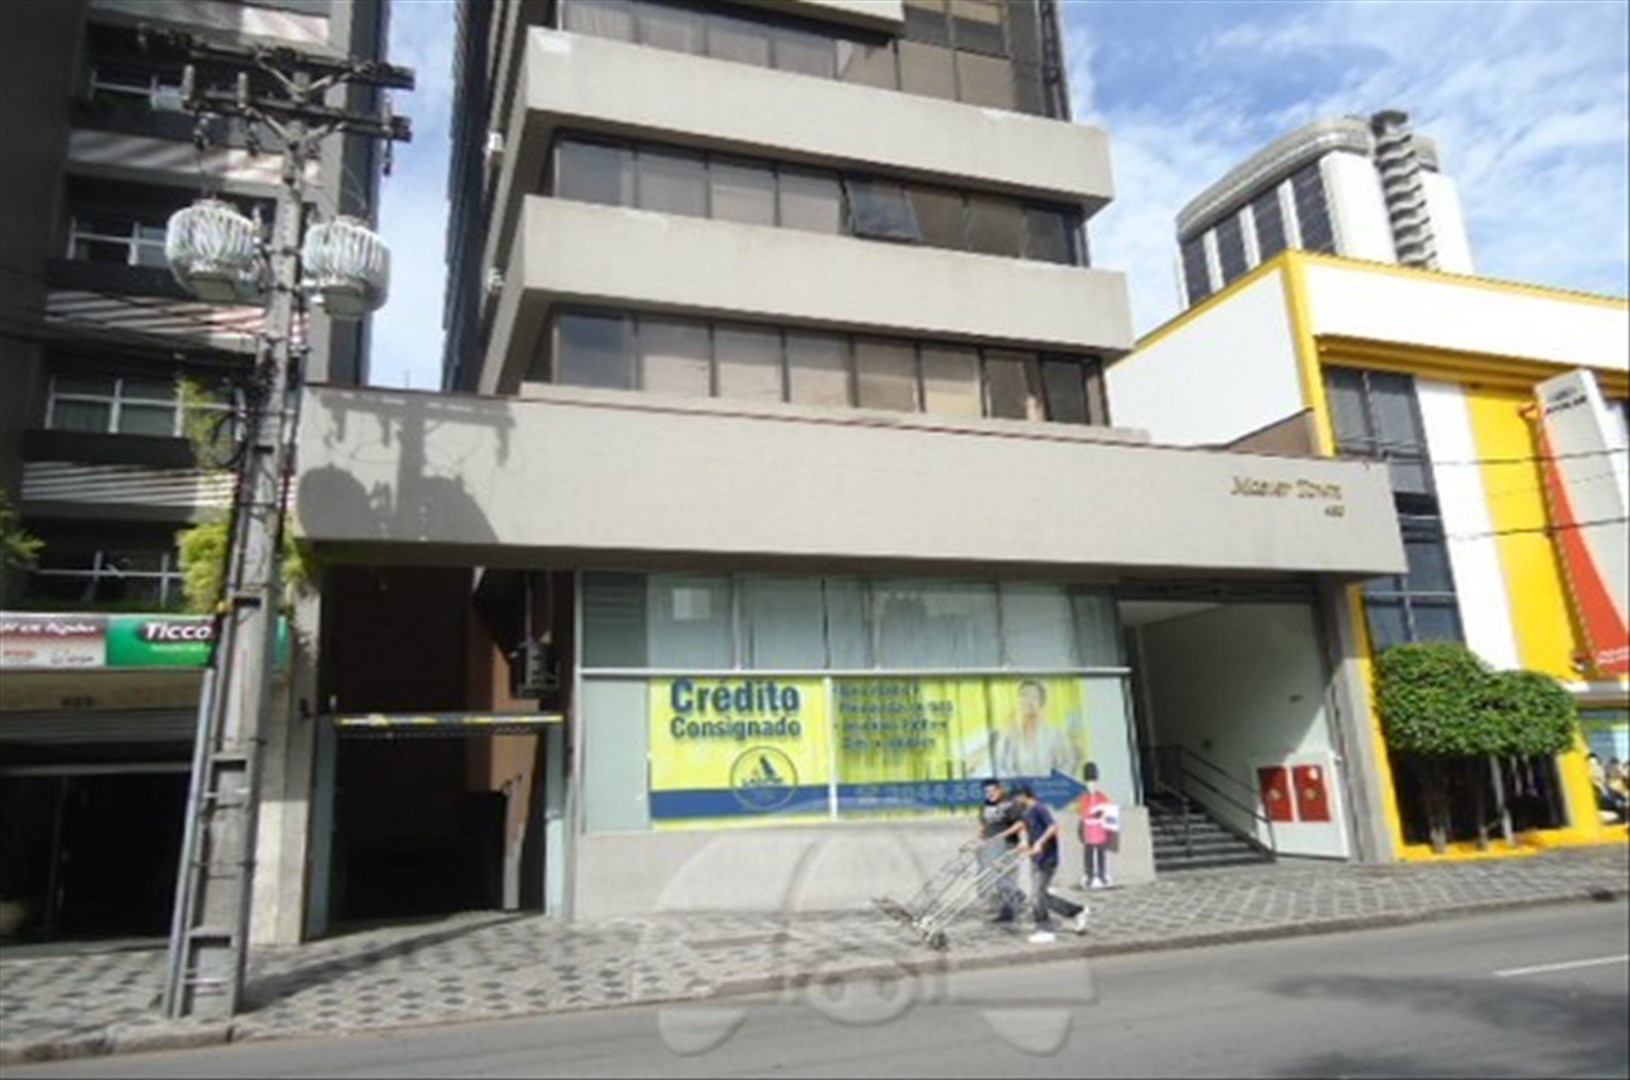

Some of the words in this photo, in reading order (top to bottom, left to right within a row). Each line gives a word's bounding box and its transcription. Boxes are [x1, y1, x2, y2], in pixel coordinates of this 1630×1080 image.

[144, 622, 214, 640] Ticco
[671, 677, 800, 714] Crédito
[670, 715, 801, 741] Consignado
